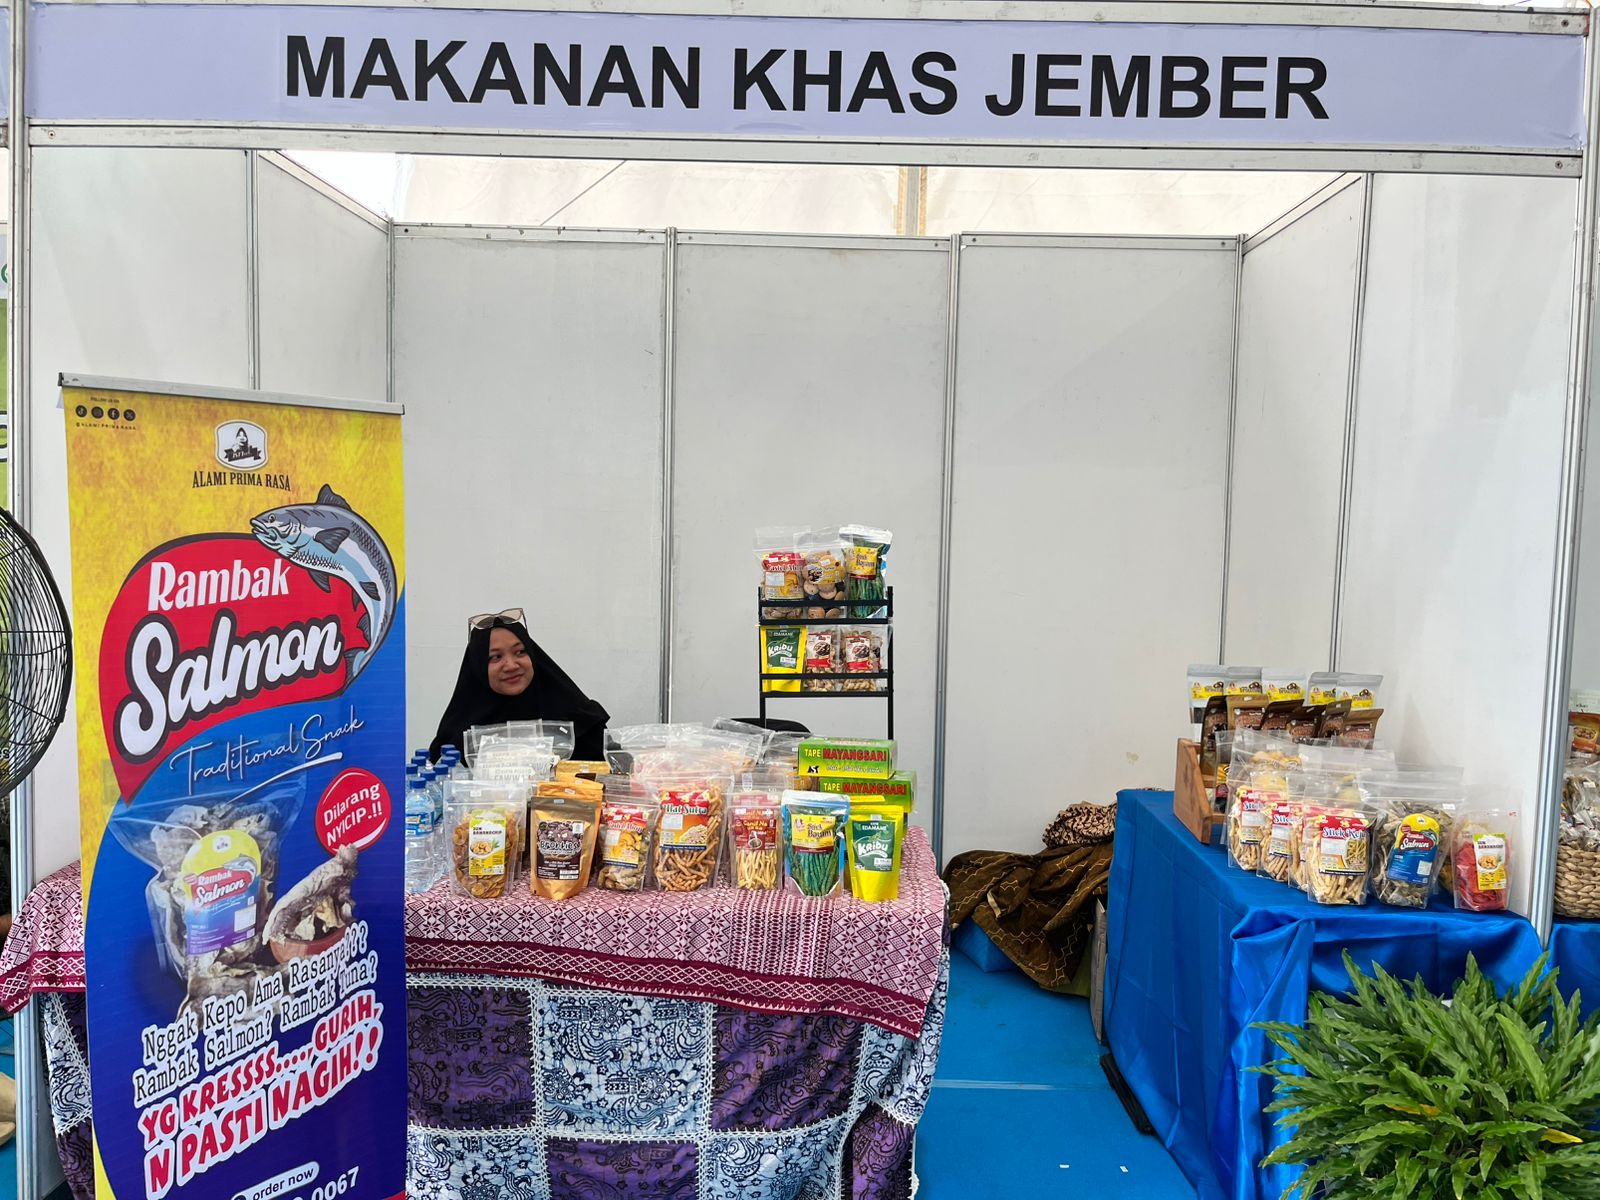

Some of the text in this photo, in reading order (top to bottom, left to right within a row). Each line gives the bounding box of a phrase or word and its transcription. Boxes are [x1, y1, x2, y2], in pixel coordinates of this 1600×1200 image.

[286, 35, 1329, 120] MAKANAN KHAS JEMBER
[192, 470, 292, 492] ALAMI PRIMA RASA
[147, 558, 292, 612] Rambak
[119, 615, 342, 757] Salmon
[169, 704, 365, 796] Traditional Snack
[804, 747, 888, 762] TAPE MAYANGSARI
[323, 783, 381, 827] Dilarang
[823, 781, 908, 796] TAPE MAYANGSARI
[195, 879, 246, 906] Salmon
[143, 924, 368, 1061] Nggak Kepo Ama Rasanya???
[134, 953, 378, 1102] Rambak Salmon? Rambak Tuna?
[141, 1103, 176, 1144] YG
[149, 1026, 379, 1194] N PASTI NAGIH!!
[251, 1167, 315, 1200] order now
